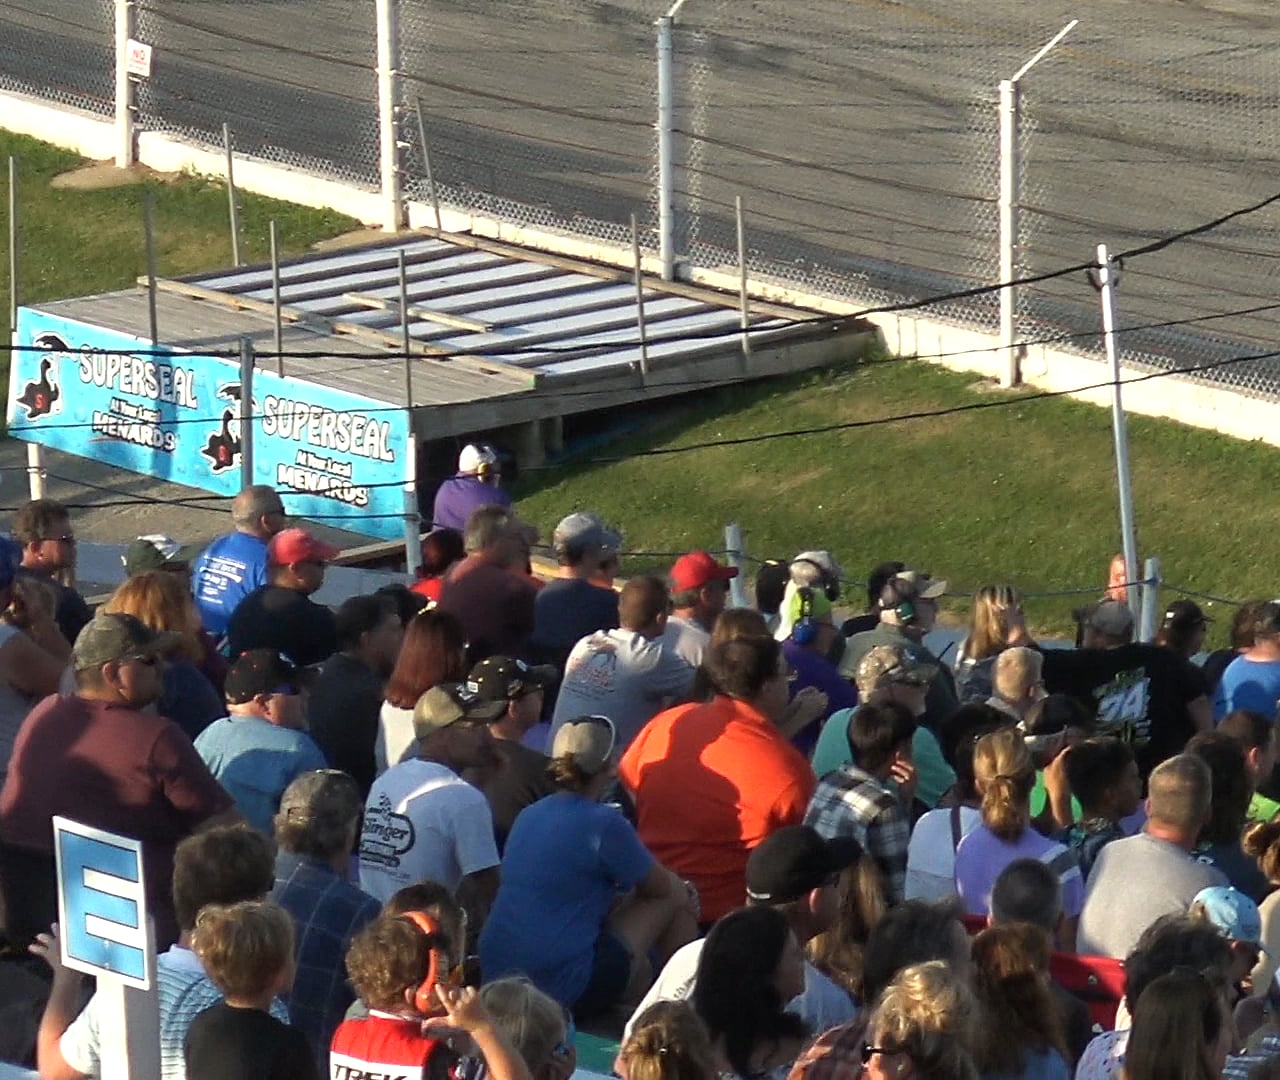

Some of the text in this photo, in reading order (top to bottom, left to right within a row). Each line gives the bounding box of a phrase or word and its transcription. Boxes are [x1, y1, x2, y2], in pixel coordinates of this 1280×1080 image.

[79, 344, 198, 409] SUPERSEAL
[92, 410, 176, 451] MENARDS
[261, 394, 395, 463] SUPERSEAL
[276, 463, 370, 507] MENARDS
[59, 829, 148, 981] E
